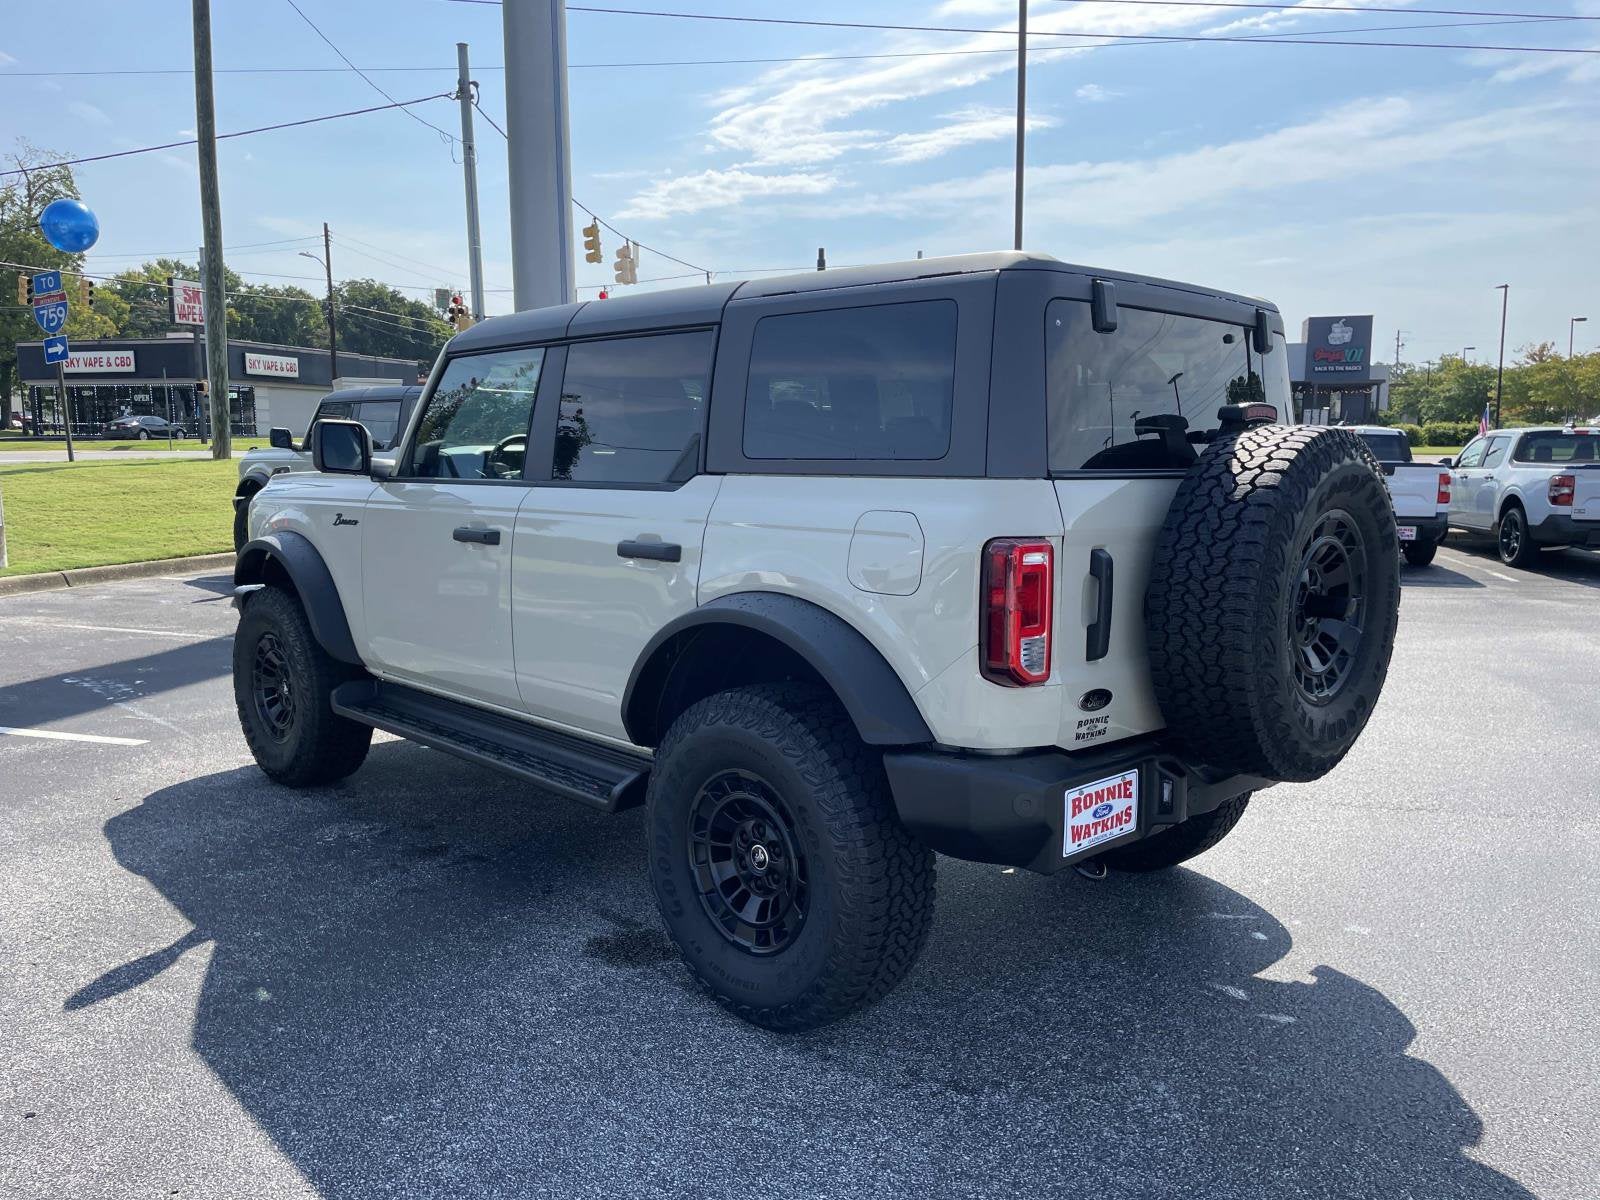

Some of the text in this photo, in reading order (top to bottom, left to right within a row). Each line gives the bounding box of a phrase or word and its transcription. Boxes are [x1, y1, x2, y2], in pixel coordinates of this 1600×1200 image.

[40, 276, 55, 289] TO
[40, 306, 65, 328] 759
[176, 303, 197, 323] VAPE
[64, 356, 132, 368] SKY VAPE & CBD
[248, 358, 298, 373] SKY VAPE & CBD
[133, 394, 150, 402] OPEN
[1077, 715, 1109, 730] RONNIE
[1075, 727, 1107, 740] WATKINS
[1071, 780, 1133, 819] RONNIE
[1071, 805, 1132, 844] WATKINS
